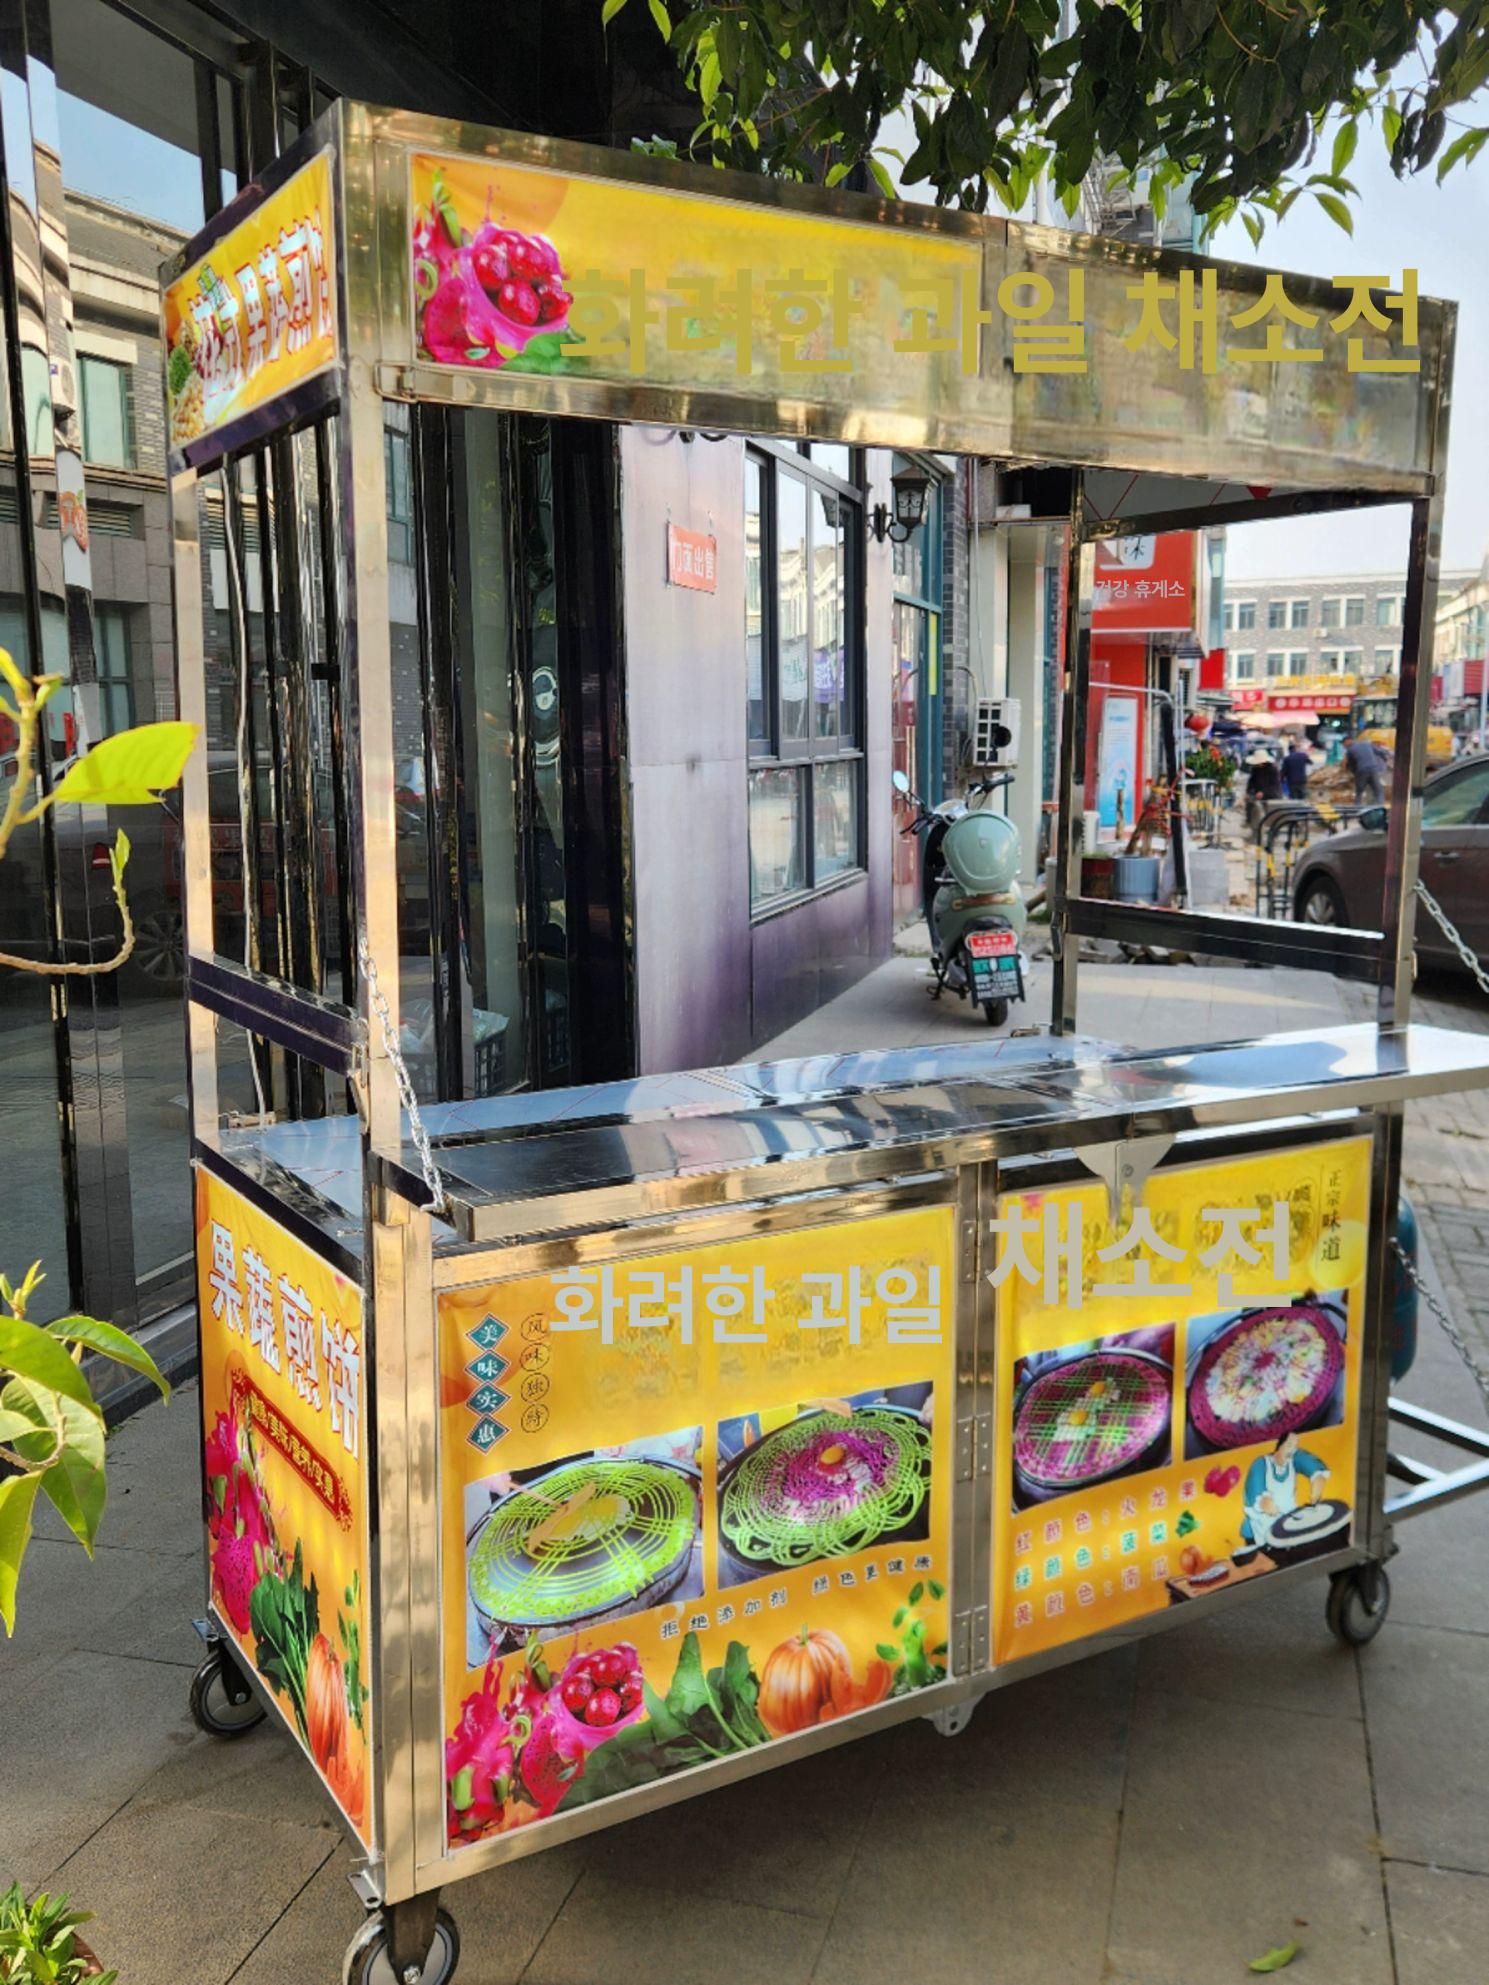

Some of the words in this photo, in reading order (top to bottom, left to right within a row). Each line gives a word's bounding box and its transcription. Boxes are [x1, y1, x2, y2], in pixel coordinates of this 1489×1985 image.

[1320, 1168, 1342, 1262] 正宗味道
[208, 1220, 360, 1461] 果蔬煎饼
[473, 1321, 502, 1446] 美味实惠
[661, 1589, 787, 1638] 拒绝添加剂
[812, 1555, 932, 1594] 绿色更健康
